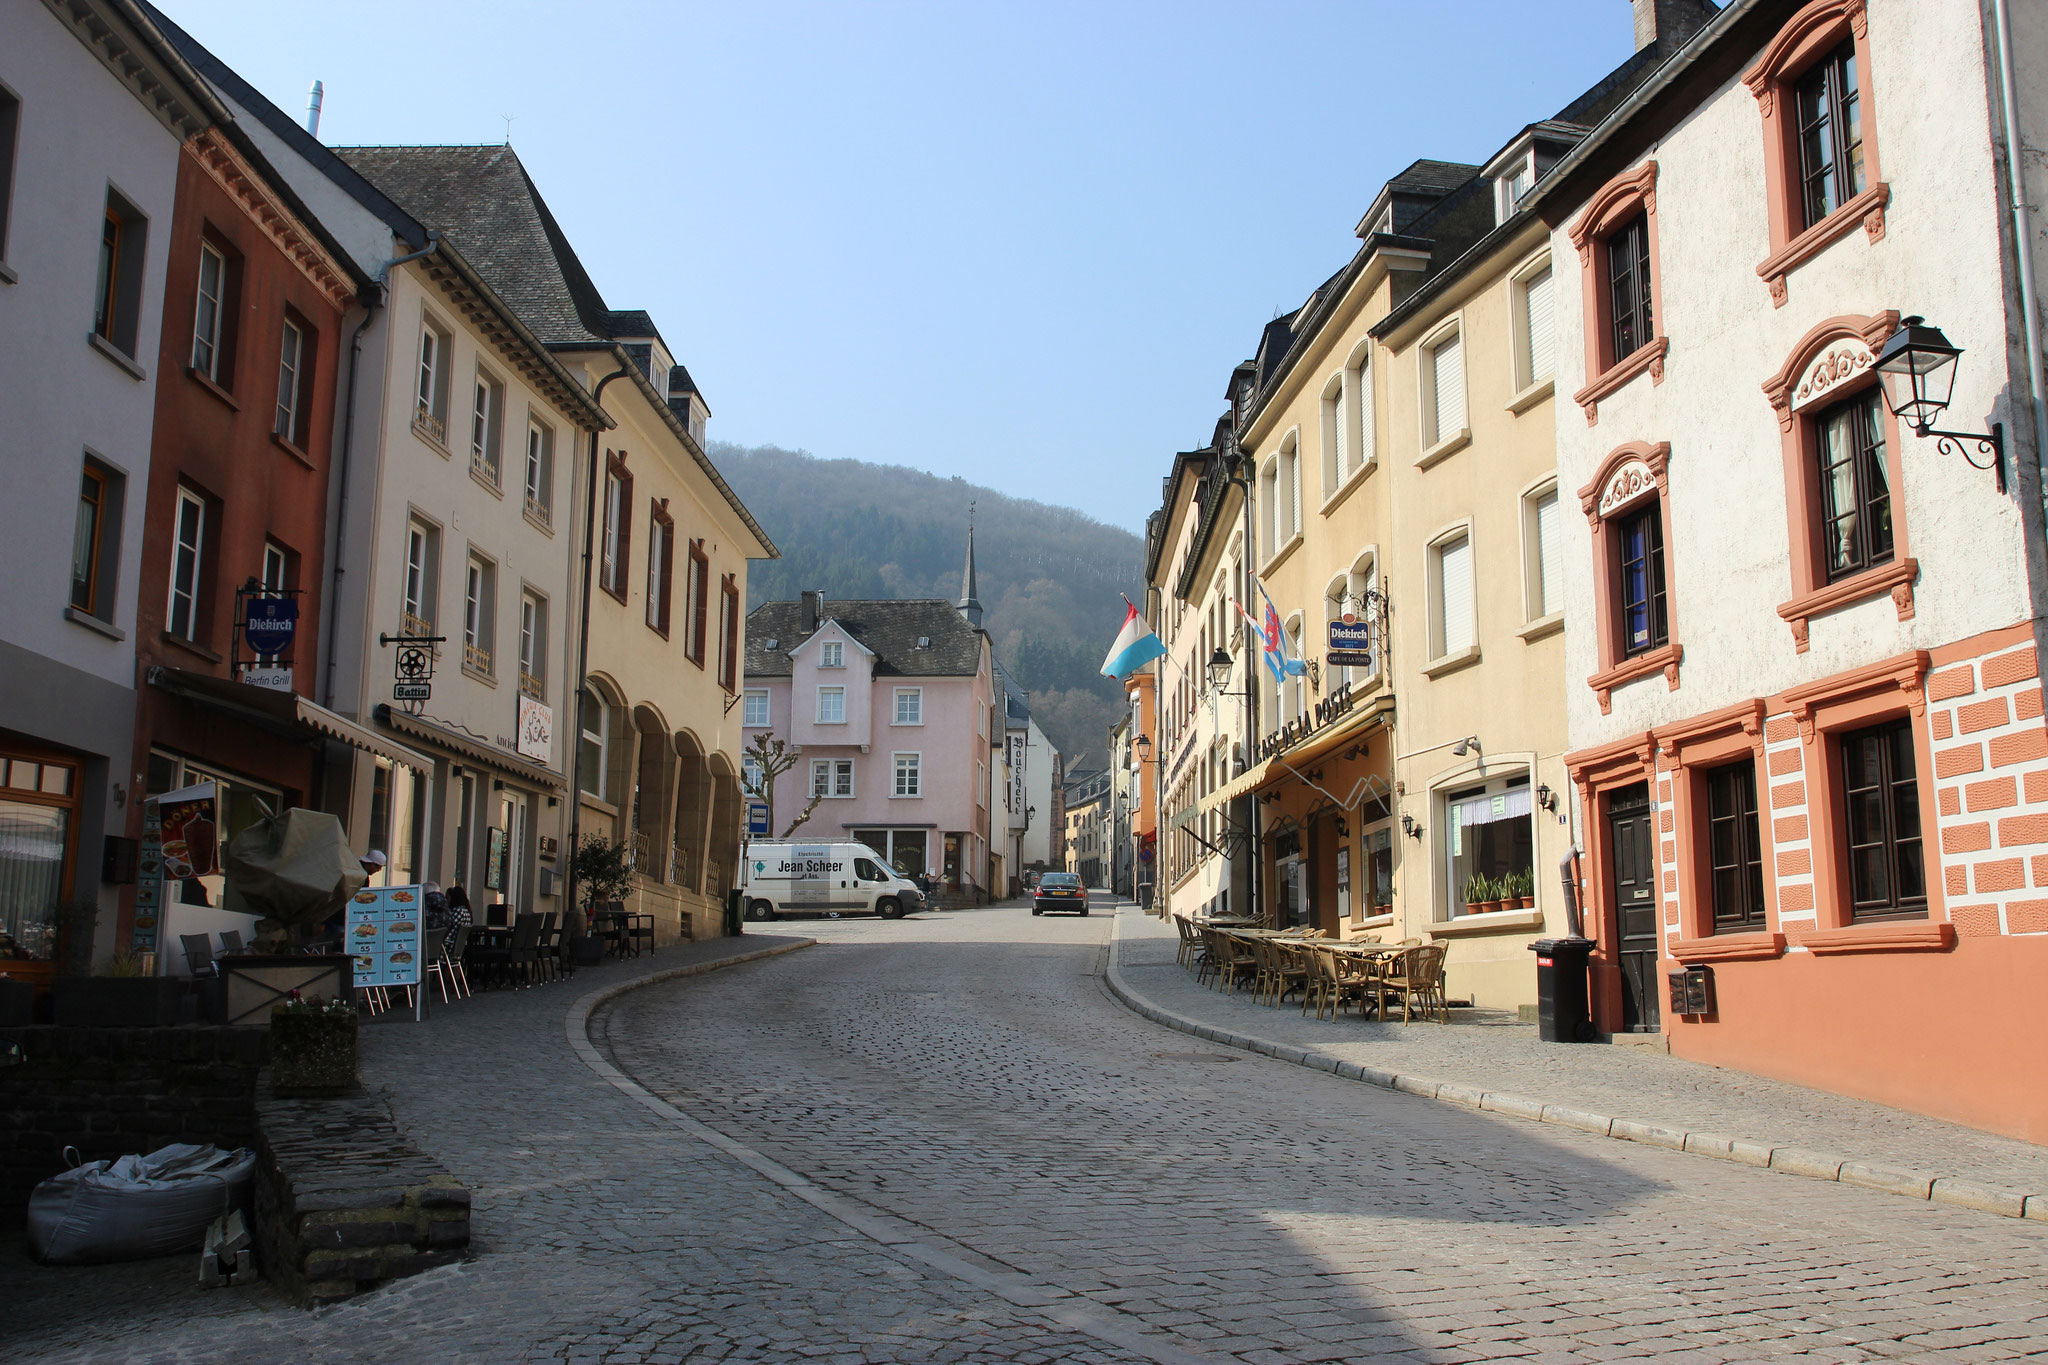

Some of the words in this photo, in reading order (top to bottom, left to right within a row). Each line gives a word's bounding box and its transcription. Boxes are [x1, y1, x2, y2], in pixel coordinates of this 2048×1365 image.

[249, 618, 292, 631] Diekirch
[1331, 627, 1368, 639] Diekirch
[271, 675, 290, 685] Grill
[397, 687, 428, 697] Battin
[1282, 720, 1296, 748] DE
[1297, 710, 1312, 740] LA
[1315, 681, 1353, 728] POSTE
[778, 860, 803, 872] Jean
[806, 859, 843, 872] Scheer
